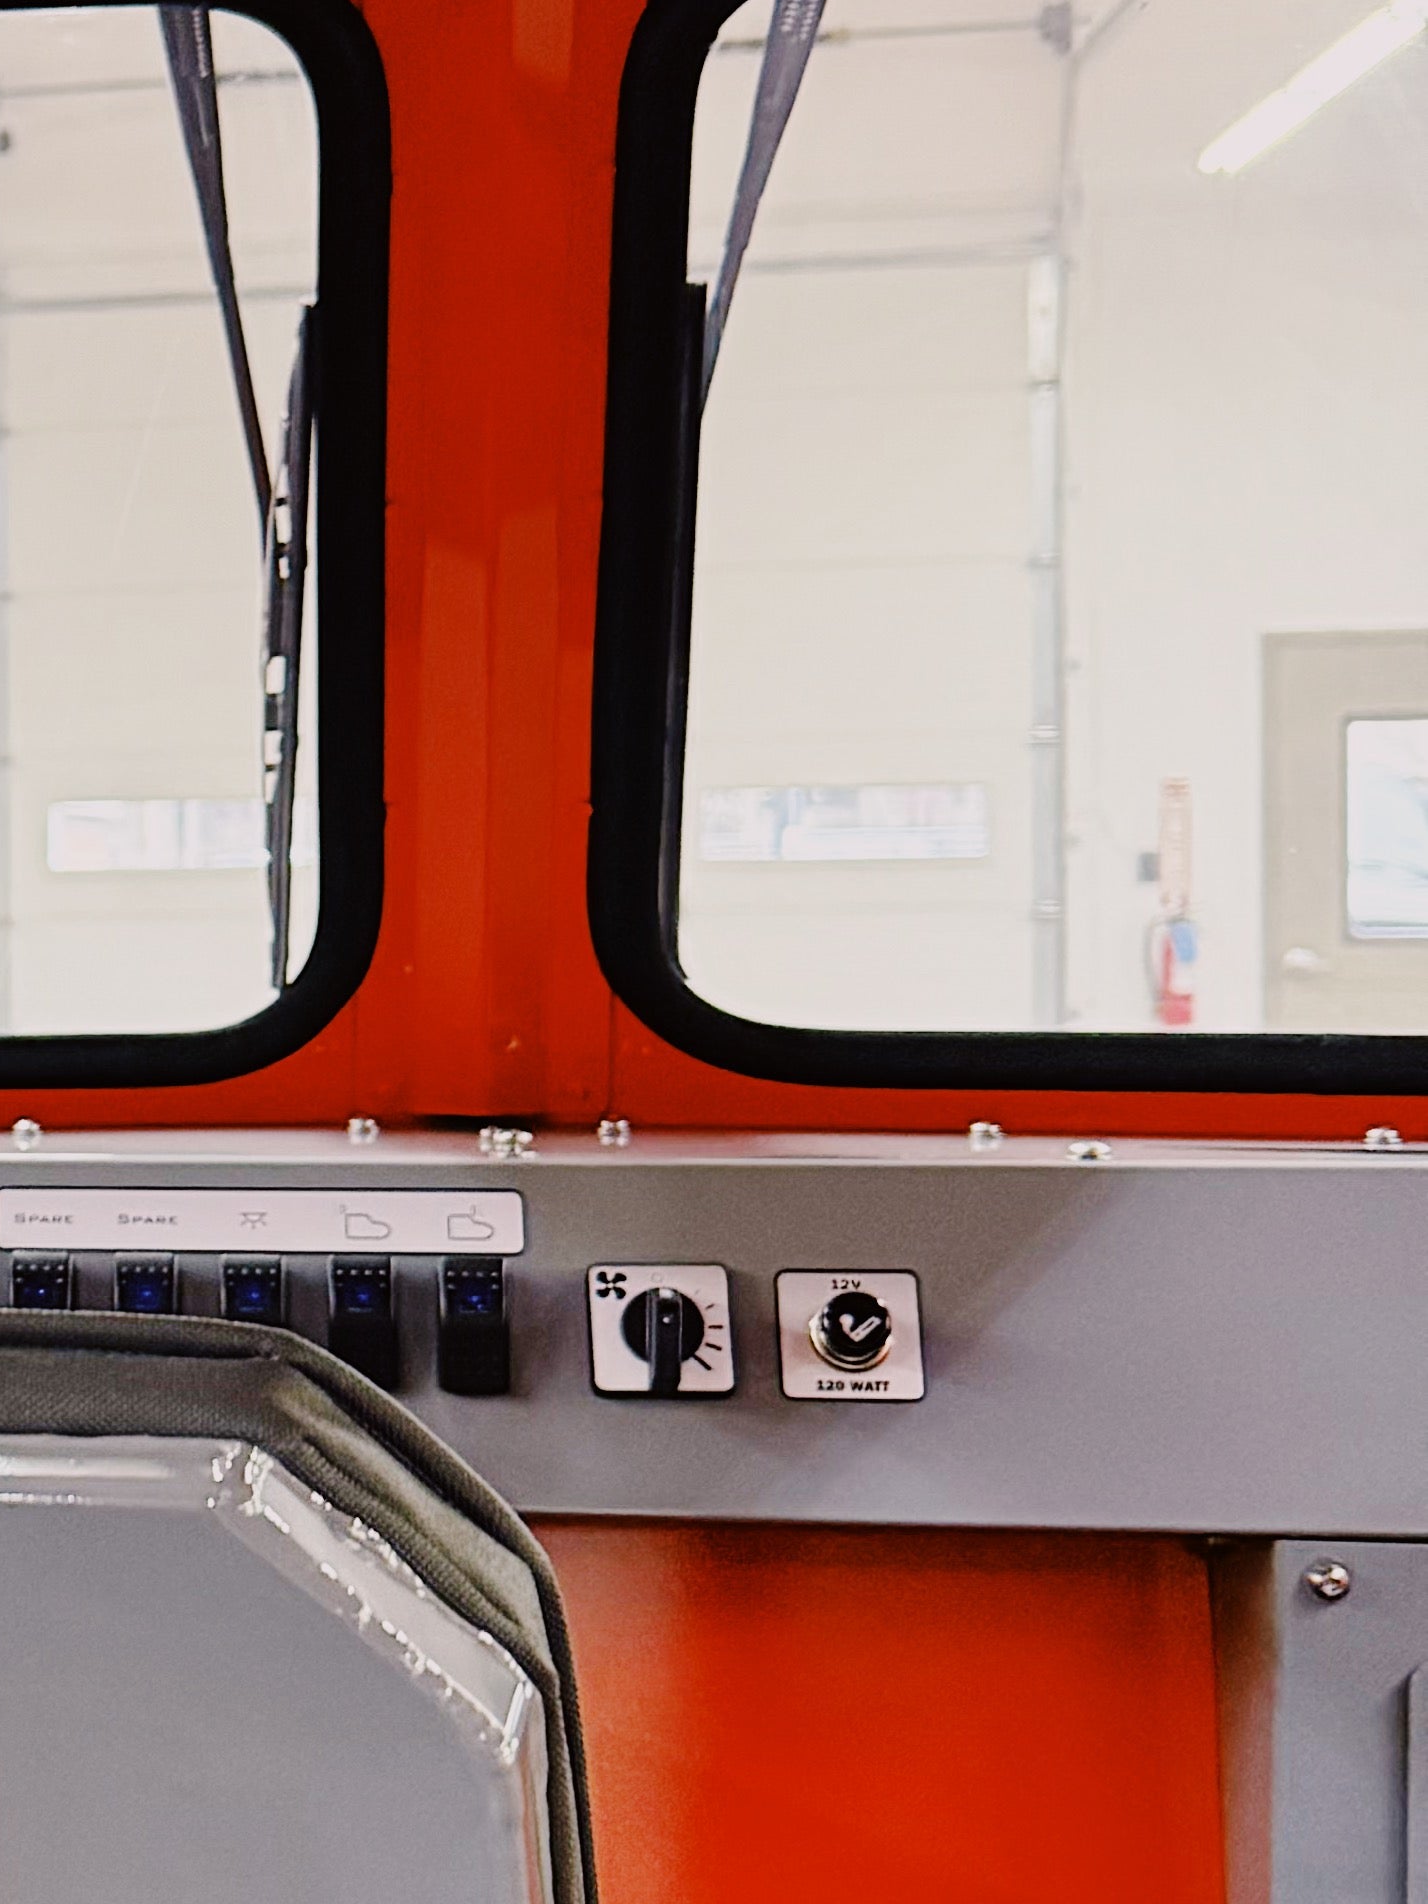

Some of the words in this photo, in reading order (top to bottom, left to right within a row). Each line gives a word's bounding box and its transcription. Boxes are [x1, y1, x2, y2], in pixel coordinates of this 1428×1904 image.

[832, 1279, 861, 1290] 12V
[817, 1380, 845, 1392] 120
[851, 1381, 890, 1392] WATT
